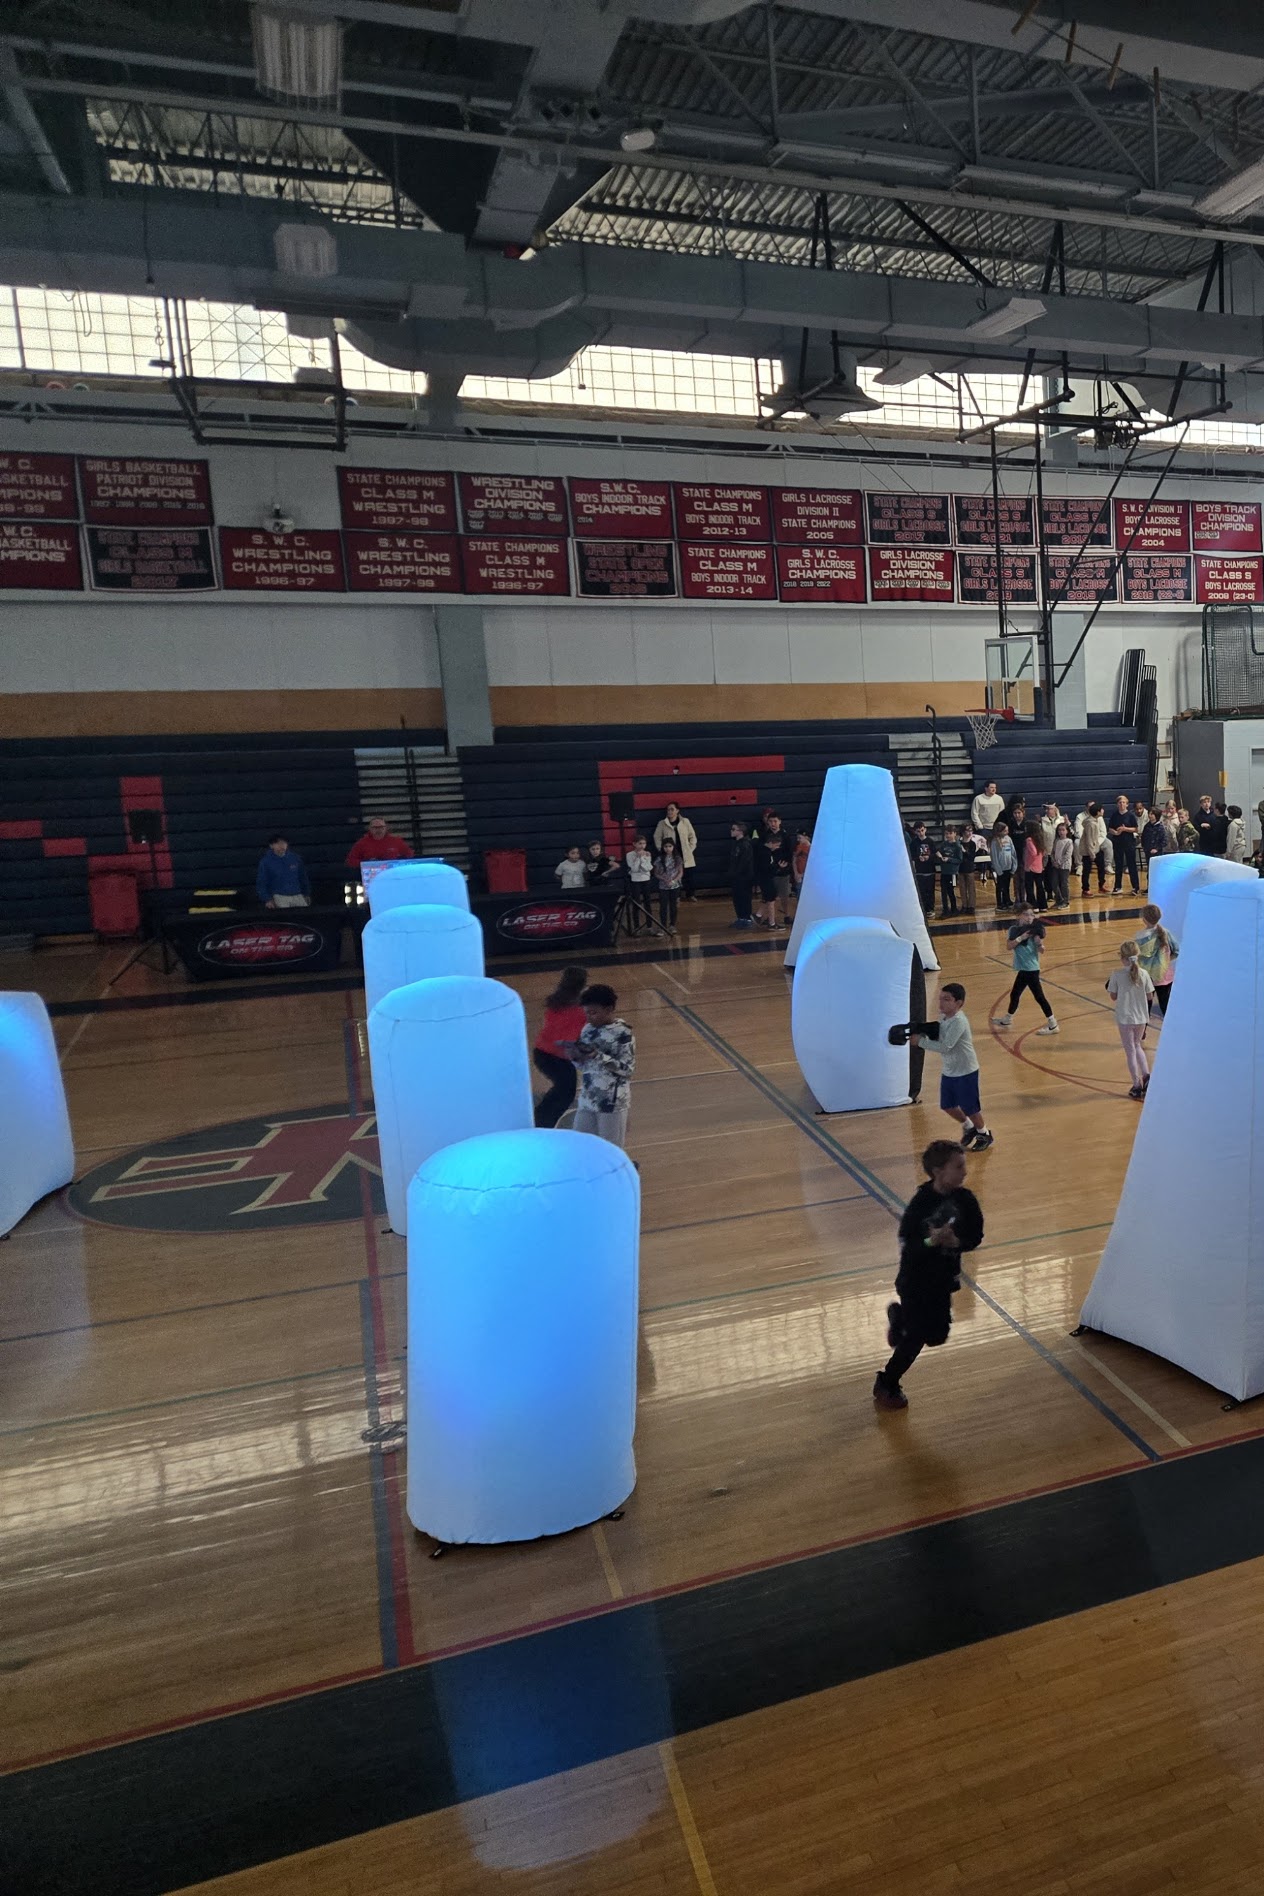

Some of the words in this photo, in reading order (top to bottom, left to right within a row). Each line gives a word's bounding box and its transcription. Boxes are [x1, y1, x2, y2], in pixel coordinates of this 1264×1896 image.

[86, 460, 120, 472] GIRLS
[126, 462, 200, 474] BASKETBALL
[96, 474, 143, 485] PATRIOT
[149, 476, 193, 486] DIVISION
[347, 474, 380, 484] STATE
[385, 474, 446, 486] CHAMPIONS
[472, 477, 554, 490] WRESTLING
[98, 486, 196, 498] CHAMPIONS
[360, 488, 417, 499] CLASS
[424, 491, 434, 500] M
[485, 489, 542, 500] DIVISION
[683, 488, 710, 498] STATE
[715, 489, 762, 500] CHAMPIONS
[575, 493, 598, 502] BOYS
[602, 494, 633, 504] INDOOR
[636, 496, 666, 504] TRACK
[782, 493, 805, 503] GIRLS
[810, 495, 852, 504] LACROSSE
[874, 496, 898, 508] STATE
[901, 497, 942, 510] CHAMPIONS
[962, 498, 984, 510] STATE
[352, 502, 445, 514] WRESTLING
[474, 500, 556, 511] CHAMPIONS
[583, 504, 661, 515] CHAMPIONS
[694, 502, 738, 511] CLASS
[742, 503, 752, 512] M
[1196, 504, 1220, 512] BOYS
[1224, 505, 1256, 514] TRACK
[797, 507, 829, 515] DIVISION
[833, 508, 839, 516] II
[882, 510, 924, 519] CLASS
[969, 511, 1009, 520] CLAS
[1012, 512, 1020, 520] S
[686, 514, 704, 524] BOYS
[708, 515, 734, 524] INDOOR
[738, 516, 761, 526] TRACK
[1050, 513, 1088, 522] CLASS
[1146, 516, 1180, 524] LACROSSE
[1208, 514, 1245, 522] DIVISION
[782, 519, 807, 528] STATE
[812, 520, 856, 529] CHAMPIONS
[873, 520, 898, 530] GIRLS
[904, 520, 946, 532] LACROSSE
[960, 522, 984, 532] GIRLS
[1201, 522, 1254, 532] CHAMPIONS
[702, 527, 746, 536] 2012-13
[806, 531, 834, 539] 2005
[0, 538, 72, 550] ASKETBALL
[469, 542, 500, 552] STATE
[505, 542, 560, 553] CHAMPIONS
[232, 548, 332, 560] WRESTLING
[357, 552, 450, 562] WRESTLING
[688, 548, 715, 558] STATE
[719, 548, 766, 559] CHAMPIONS
[880, 551, 902, 559] GIRLS
[904, 552, 944, 560] LACROSSE
[486, 556, 530, 566] CLASS
[536, 556, 545, 566] M
[699, 560, 744, 570] CLASS
[748, 562, 757, 572] M
[788, 560, 810, 568] GIRLS
[814, 560, 855, 569] LACROSSE
[890, 562, 935, 570] DIVISION
[965, 556, 988, 566] STATE
[1050, 556, 1070, 567] STATE
[1128, 557, 1148, 568] STATE
[1151, 557, 1186, 568] CHAMPIONS
[1202, 560, 1222, 568] STATE
[1224, 561, 1258, 569] CHAMPIONS
[232, 563, 334, 574] CHAMPIONS
[359, 565, 450, 576] CHAMPIONS
[479, 568, 554, 579] WRESTLING
[972, 568, 1012, 578] CLAS
[1016, 569, 1024, 578] S
[1134, 568, 1170, 578] CLASS
[1174, 568, 1182, 578] M
[586, 570, 668, 582] CHAMPIONS
[692, 573, 710, 582] BOYS
[714, 574, 740, 584] INDOOR
[742, 574, 766, 584] TRACK
[788, 570, 856, 579] CHAMPIONS
[882, 570, 944, 579] CHAMPIONS
[1209, 571, 1242, 580] CLASS
[1245, 572, 1252, 580] S
[964, 578, 988, 588] GIRLS
[1128, 579, 1147, 589] BOYS
[1150, 579, 1188, 590] LACROSSE
[1205, 582, 1222, 590] BOYS
[1224, 582, 1256, 590] LACROSSE
[706, 586, 753, 594] 2013-14
[1233, 592, 1255, 601] (23-0)
[502, 913, 560, 926] LASER
[566, 911, 597, 920] TAG
[205, 936, 272, 950] LASER
[279, 934, 315, 944] TAG
